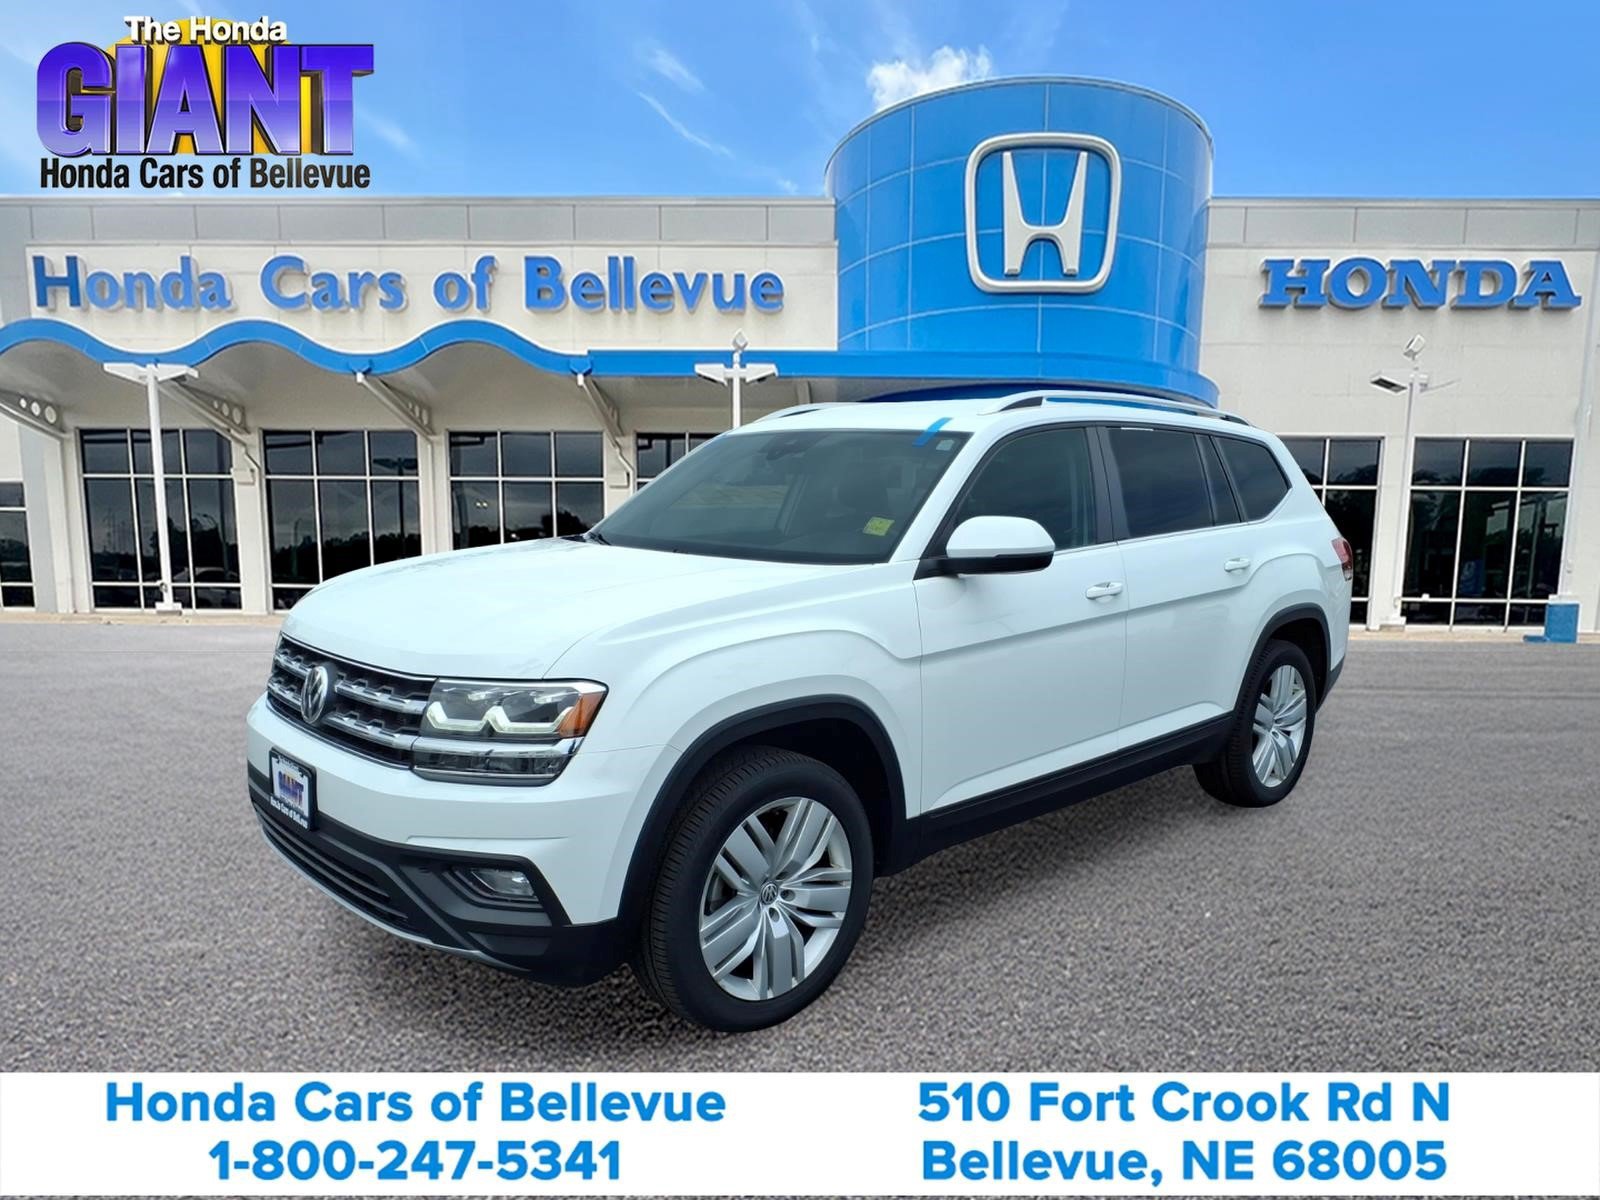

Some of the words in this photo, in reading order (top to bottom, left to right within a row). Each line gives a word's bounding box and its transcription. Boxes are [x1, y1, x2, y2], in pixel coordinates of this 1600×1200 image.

[33, 255, 234, 314] Honda
[261, 255, 406, 314] Cars
[433, 254, 498, 314] of
[524, 255, 785, 314] Bellevue
[1259, 257, 1582, 310] HONDA
